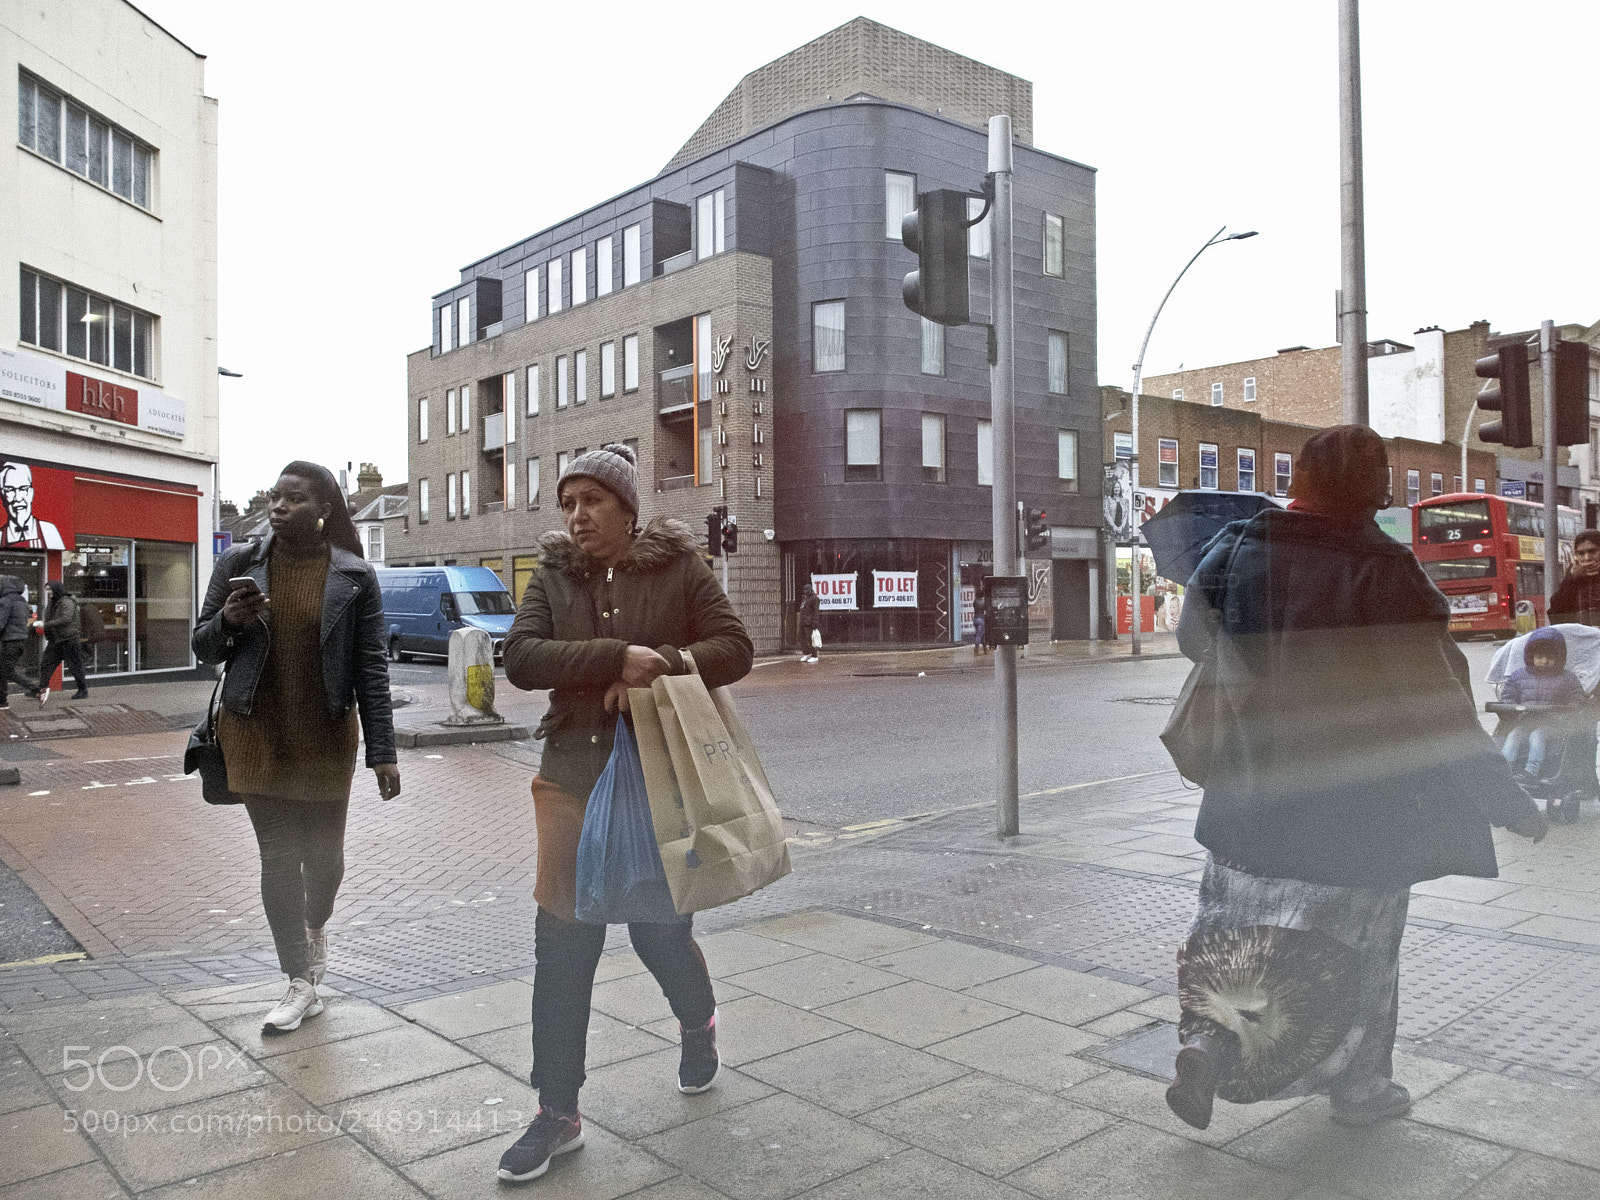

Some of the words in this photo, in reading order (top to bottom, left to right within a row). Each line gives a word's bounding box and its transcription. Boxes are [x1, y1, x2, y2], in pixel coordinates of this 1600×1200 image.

[1, 370, 56, 390] SOLICITORS
[82, 378, 125, 413] hkh
[148, 408, 185, 423] ADVOCATES
[1447, 529, 1461, 540] 25
[814, 581, 829, 595] TO
[832, 580, 853, 595] LET
[877, 577, 894, 592] TO
[897, 577, 915, 592] LET
